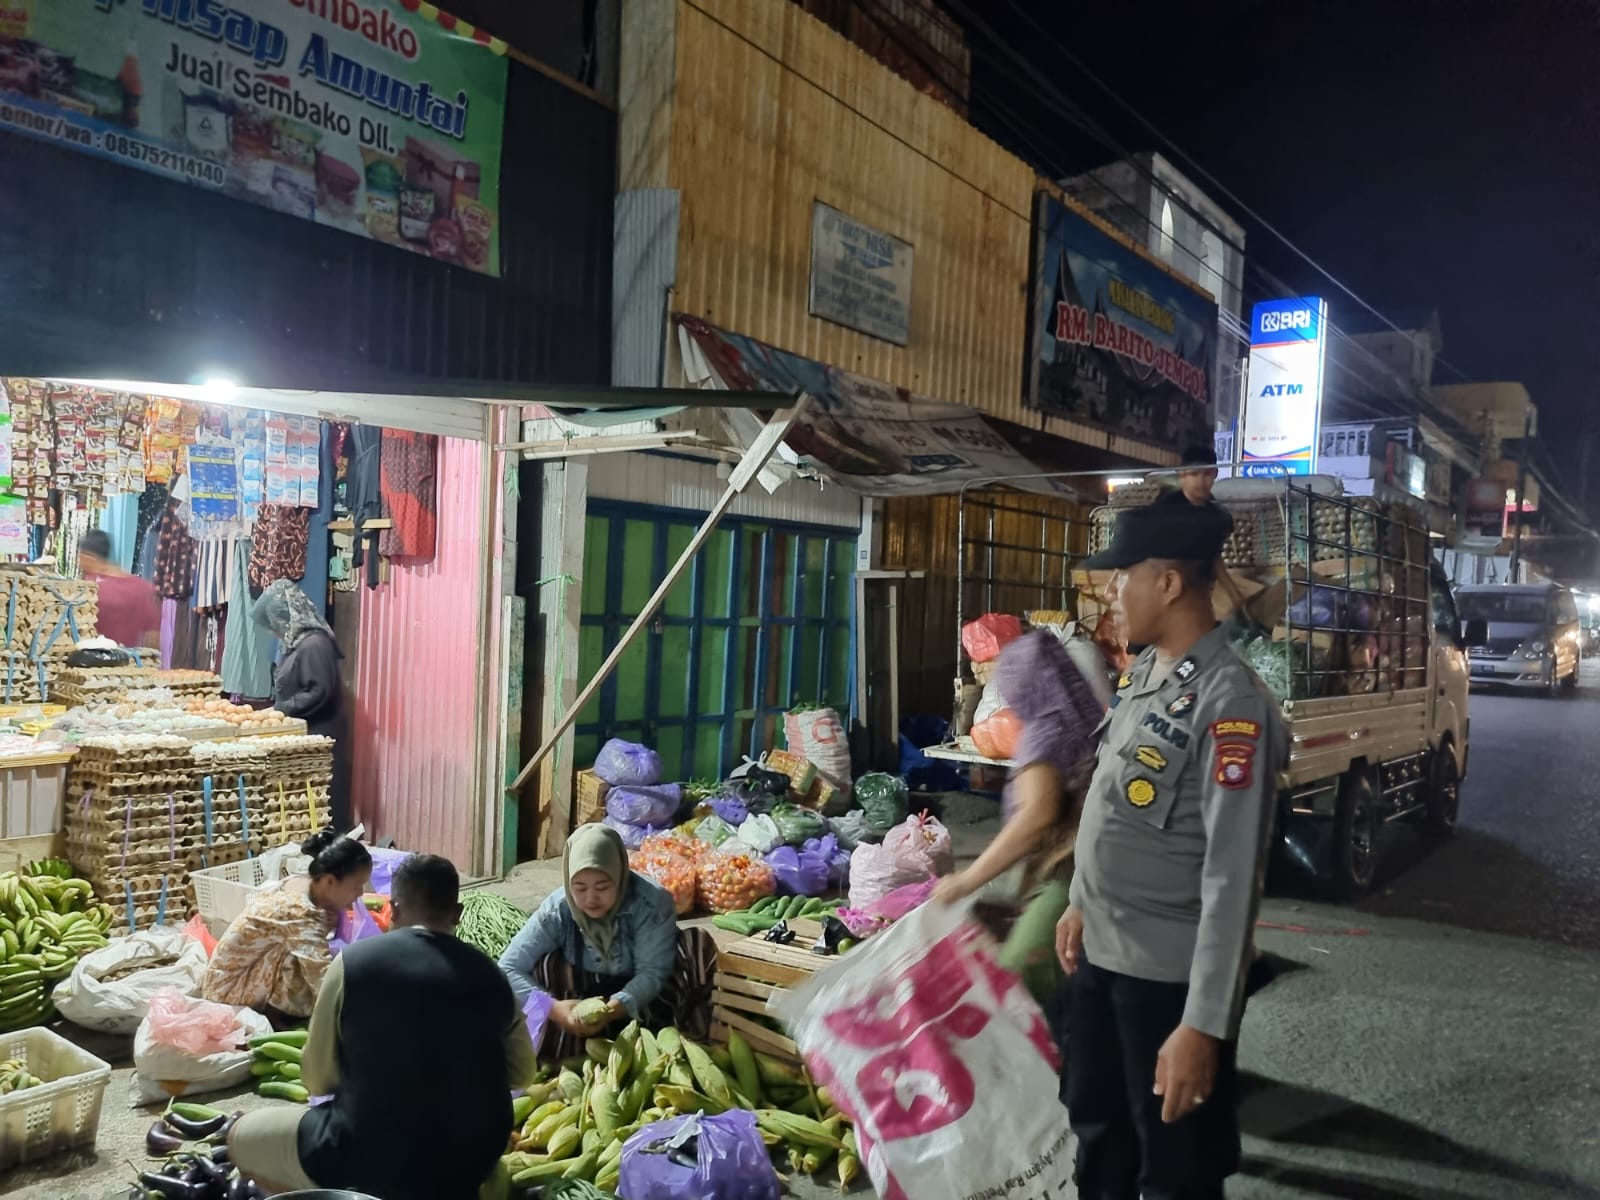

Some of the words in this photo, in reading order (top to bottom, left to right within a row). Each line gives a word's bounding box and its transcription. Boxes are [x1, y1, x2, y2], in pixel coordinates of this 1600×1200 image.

[166, 43, 222, 89] Jual
[233, 69, 350, 135] Sembako
[360, 117, 395, 153] Dll.
[299, 32, 468, 141] Amuntai
[105, 133, 224, 184] 085752114140
[1057, 303, 1091, 345] RM.
[1095, 317, 1153, 363] BARITO
[1280, 309, 1310, 329] BRI
[1260, 383, 1303, 398] ATM
